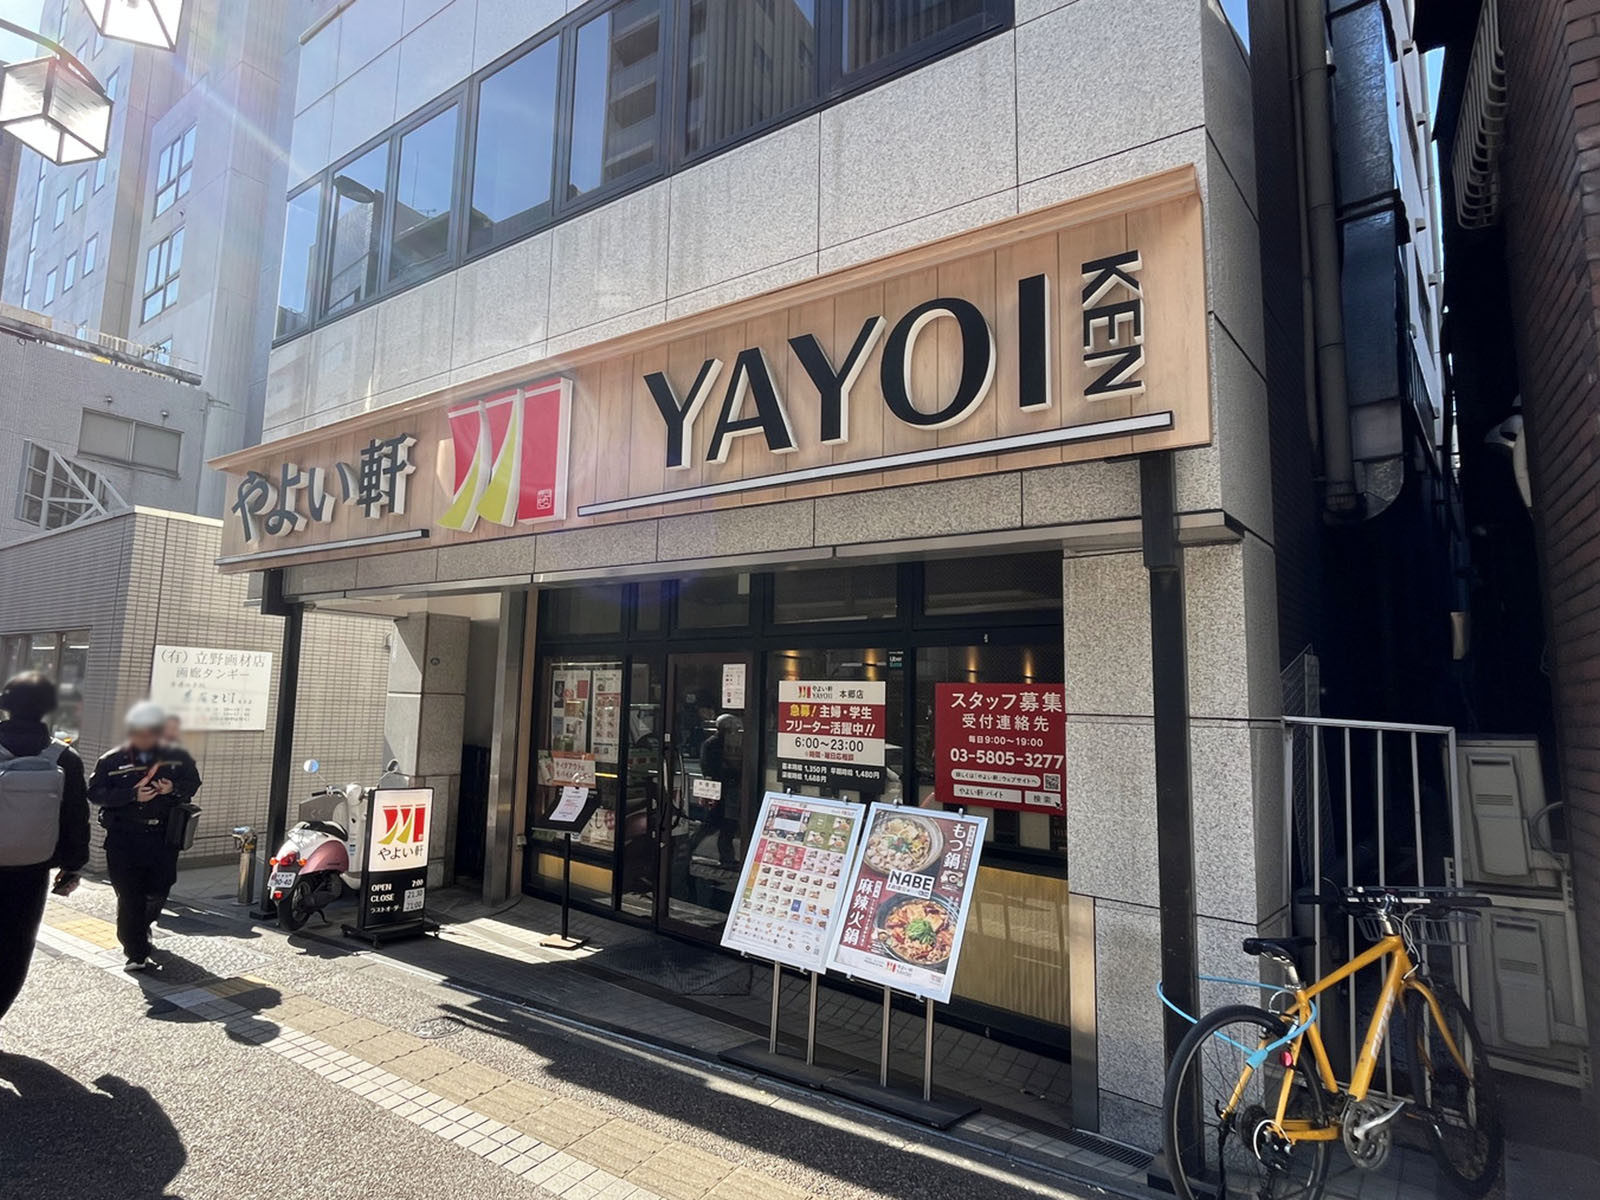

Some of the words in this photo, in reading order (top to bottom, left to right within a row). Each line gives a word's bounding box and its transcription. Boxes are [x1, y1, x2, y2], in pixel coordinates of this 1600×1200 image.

[1082, 250, 1145, 402] KEN
[644, 273, 1051, 470] YAYOI
[232, 432, 417, 546] やよい軒
[839, 690, 864, 699] 本郷店
[951, 691, 1063, 713] スタッフ募集
[819, 705, 873, 720] 主婦・学生
[962, 713, 1049, 732] 受付連絡先
[950, 747, 1064, 769] 03-5805-3277
[959, 787, 984, 797] やよい軒
[377, 844, 424, 861] やよい軒
[943, 823, 966, 870] もつ鍋
[371, 883, 393, 892] OPEN
[890, 870, 933, 892] NABE
[370, 893, 395, 903] CLOSE
[843, 878, 875, 946] 麻辣火鍋
